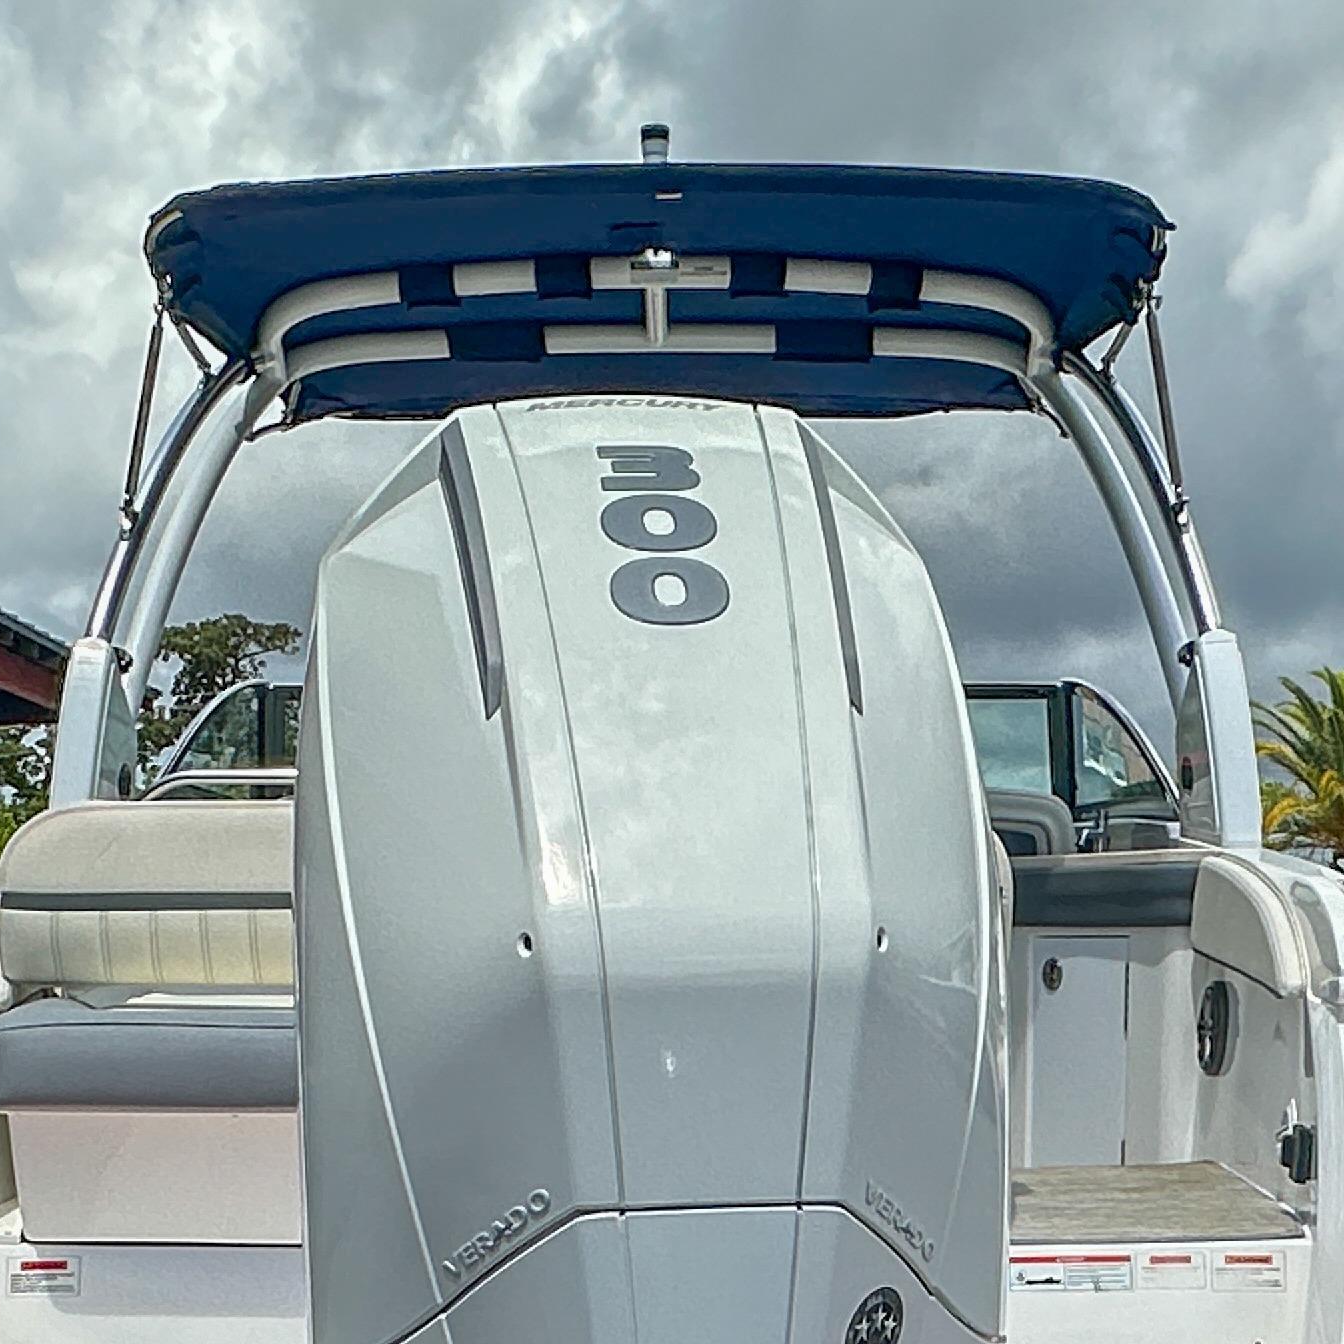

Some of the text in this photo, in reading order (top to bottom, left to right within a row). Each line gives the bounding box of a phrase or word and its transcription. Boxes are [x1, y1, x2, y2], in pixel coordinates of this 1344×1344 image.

[525, 398, 728, 412] MERCURY
[596, 445, 730, 626] 300
[442, 1188, 551, 1278] VERADO
[864, 1179, 935, 1263] VERADO
